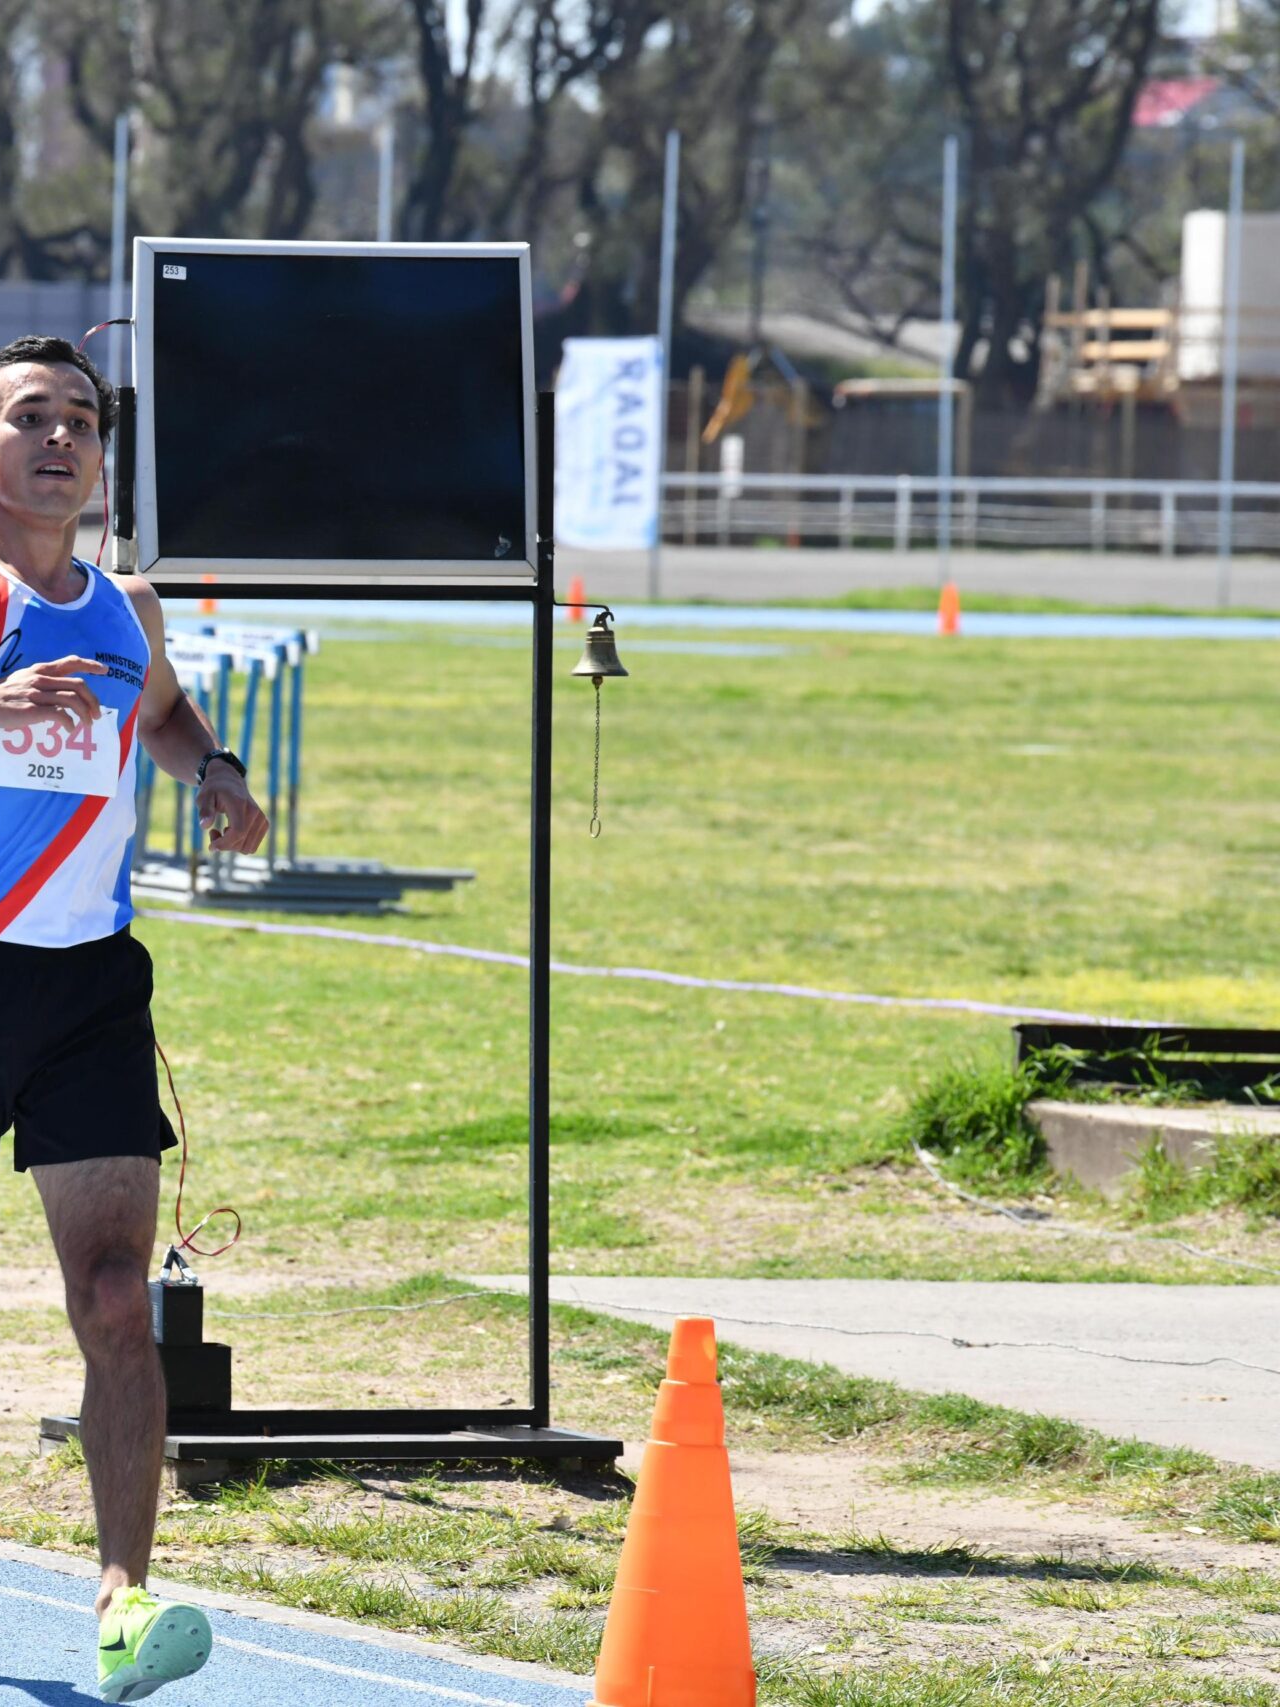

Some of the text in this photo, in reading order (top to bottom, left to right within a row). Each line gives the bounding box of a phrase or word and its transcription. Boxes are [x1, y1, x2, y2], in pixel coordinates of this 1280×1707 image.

[165, 265, 179, 275] 253
[95, 652, 143, 675] MINISTERIO
[2, 720, 97, 761] 534
[27, 764, 64, 780] 2025
